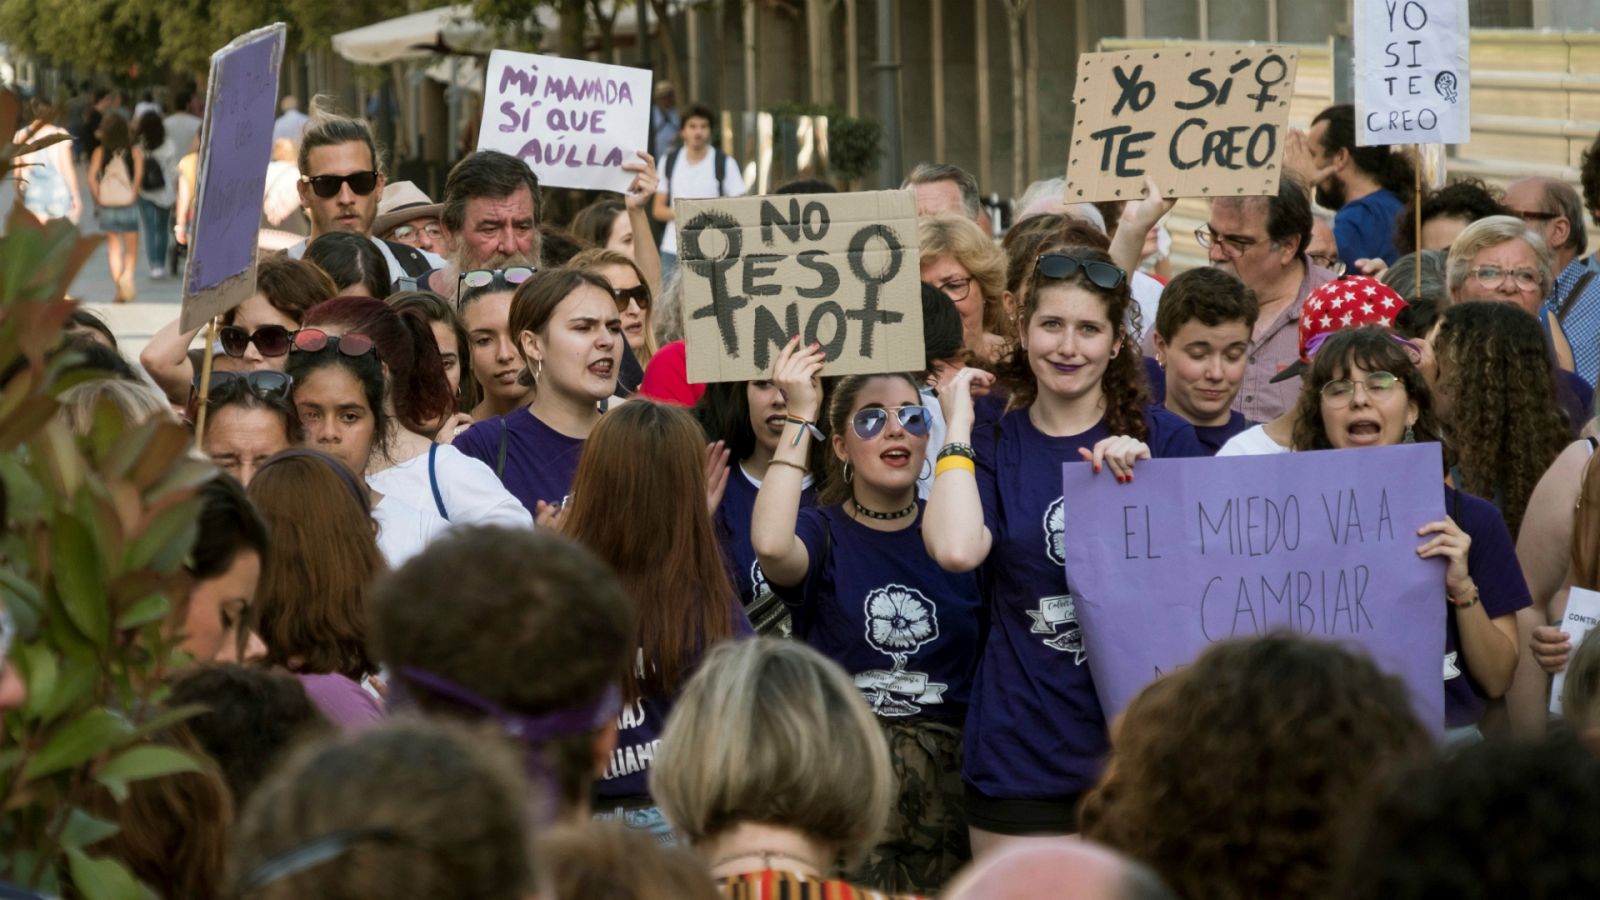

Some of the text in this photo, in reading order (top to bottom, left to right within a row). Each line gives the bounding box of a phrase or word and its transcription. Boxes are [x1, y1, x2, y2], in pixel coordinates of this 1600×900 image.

[1386, 0, 1427, 32] YO
[1384, 40, 1422, 68] SI
[544, 75, 633, 107] MANADA
[1384, 75, 1422, 96] TE
[546, 108, 607, 134] QUE
[1366, 108, 1437, 132] CREO
[516, 135, 623, 167] AÚLLA
[1090, 118, 1277, 177] TE CREO
[760, 198, 831, 247] NO
[742, 249, 841, 298] ES
[753, 300, 847, 371] NO
[1123, 488, 1394, 559] EL MIEDO VA A
[1200, 564, 1373, 643] CAMBIAR
